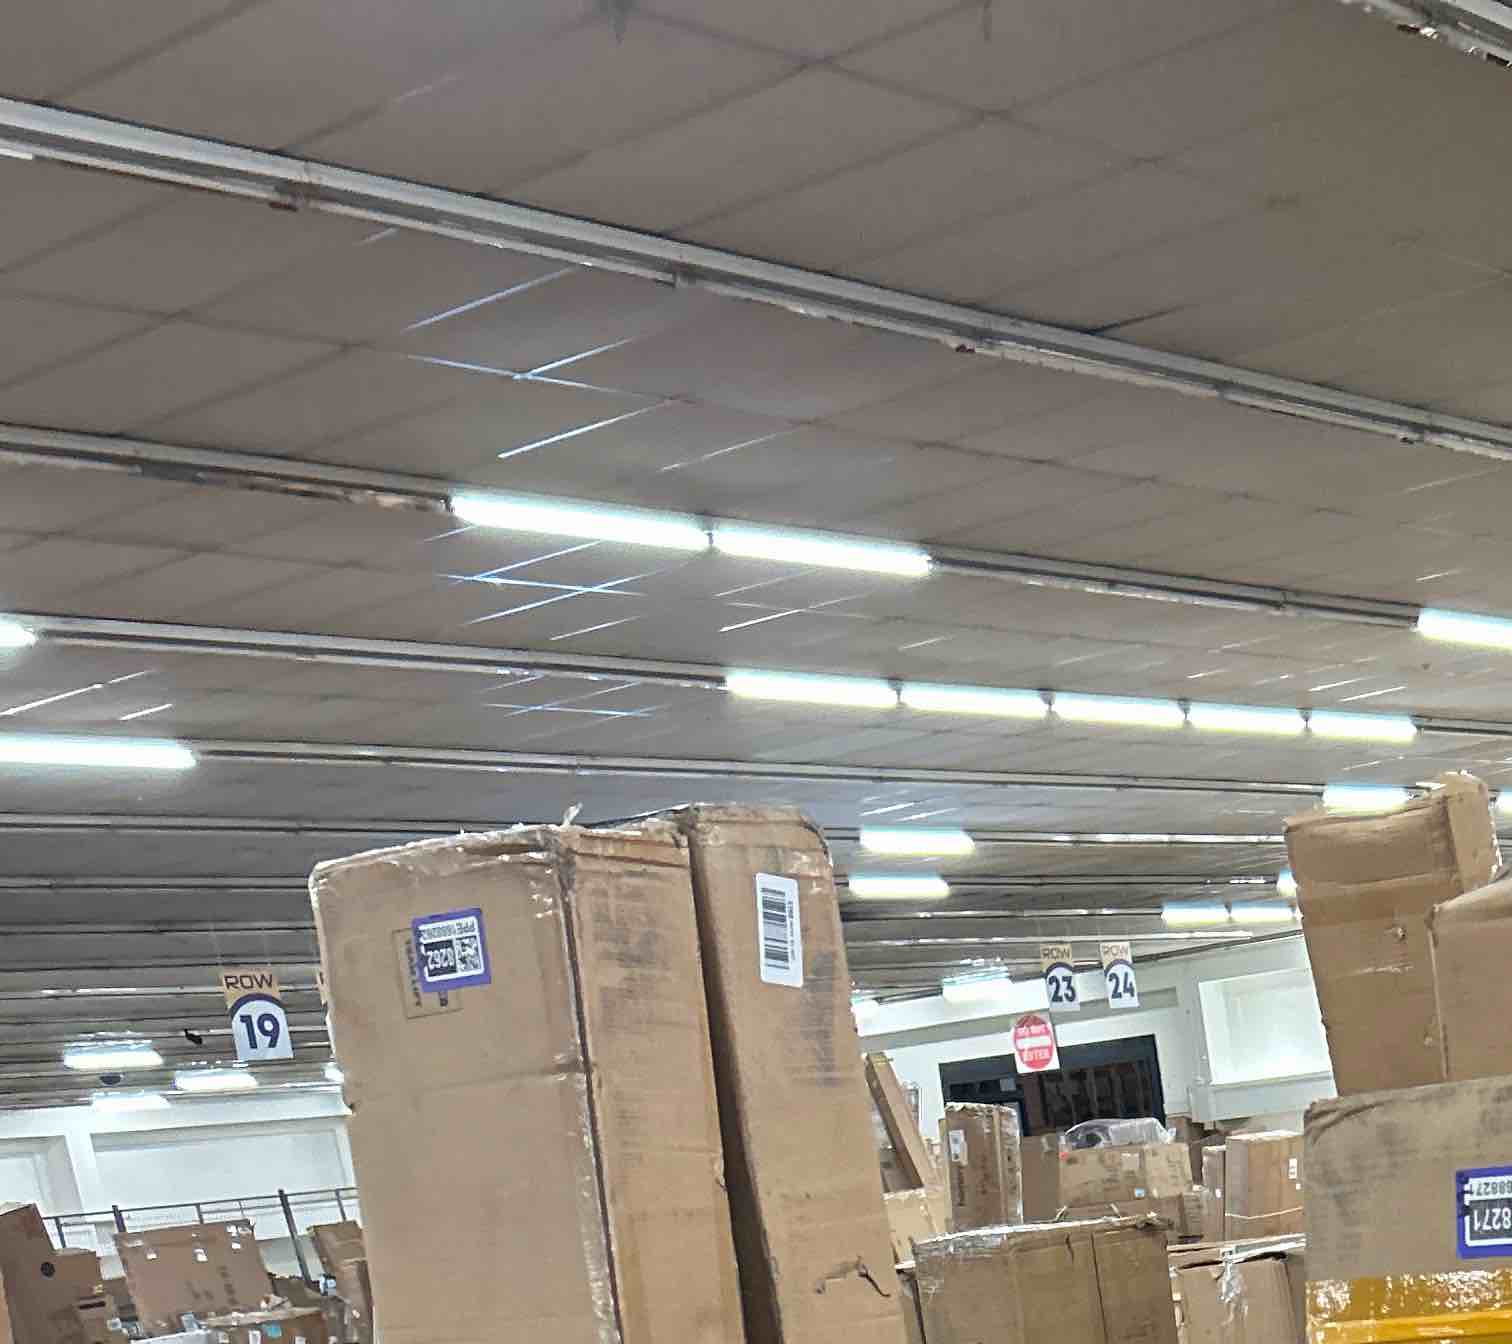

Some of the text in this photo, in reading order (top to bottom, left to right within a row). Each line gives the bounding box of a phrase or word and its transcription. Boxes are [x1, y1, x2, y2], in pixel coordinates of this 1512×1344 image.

[1042, 947, 1071, 959] ROW
[224, 974, 273, 990] ROW
[1048, 975, 1077, 1002] 23
[1108, 971, 1135, 1000] 24
[239, 1013, 281, 1049] 19
[1473, 1206, 1512, 1231] 8271
